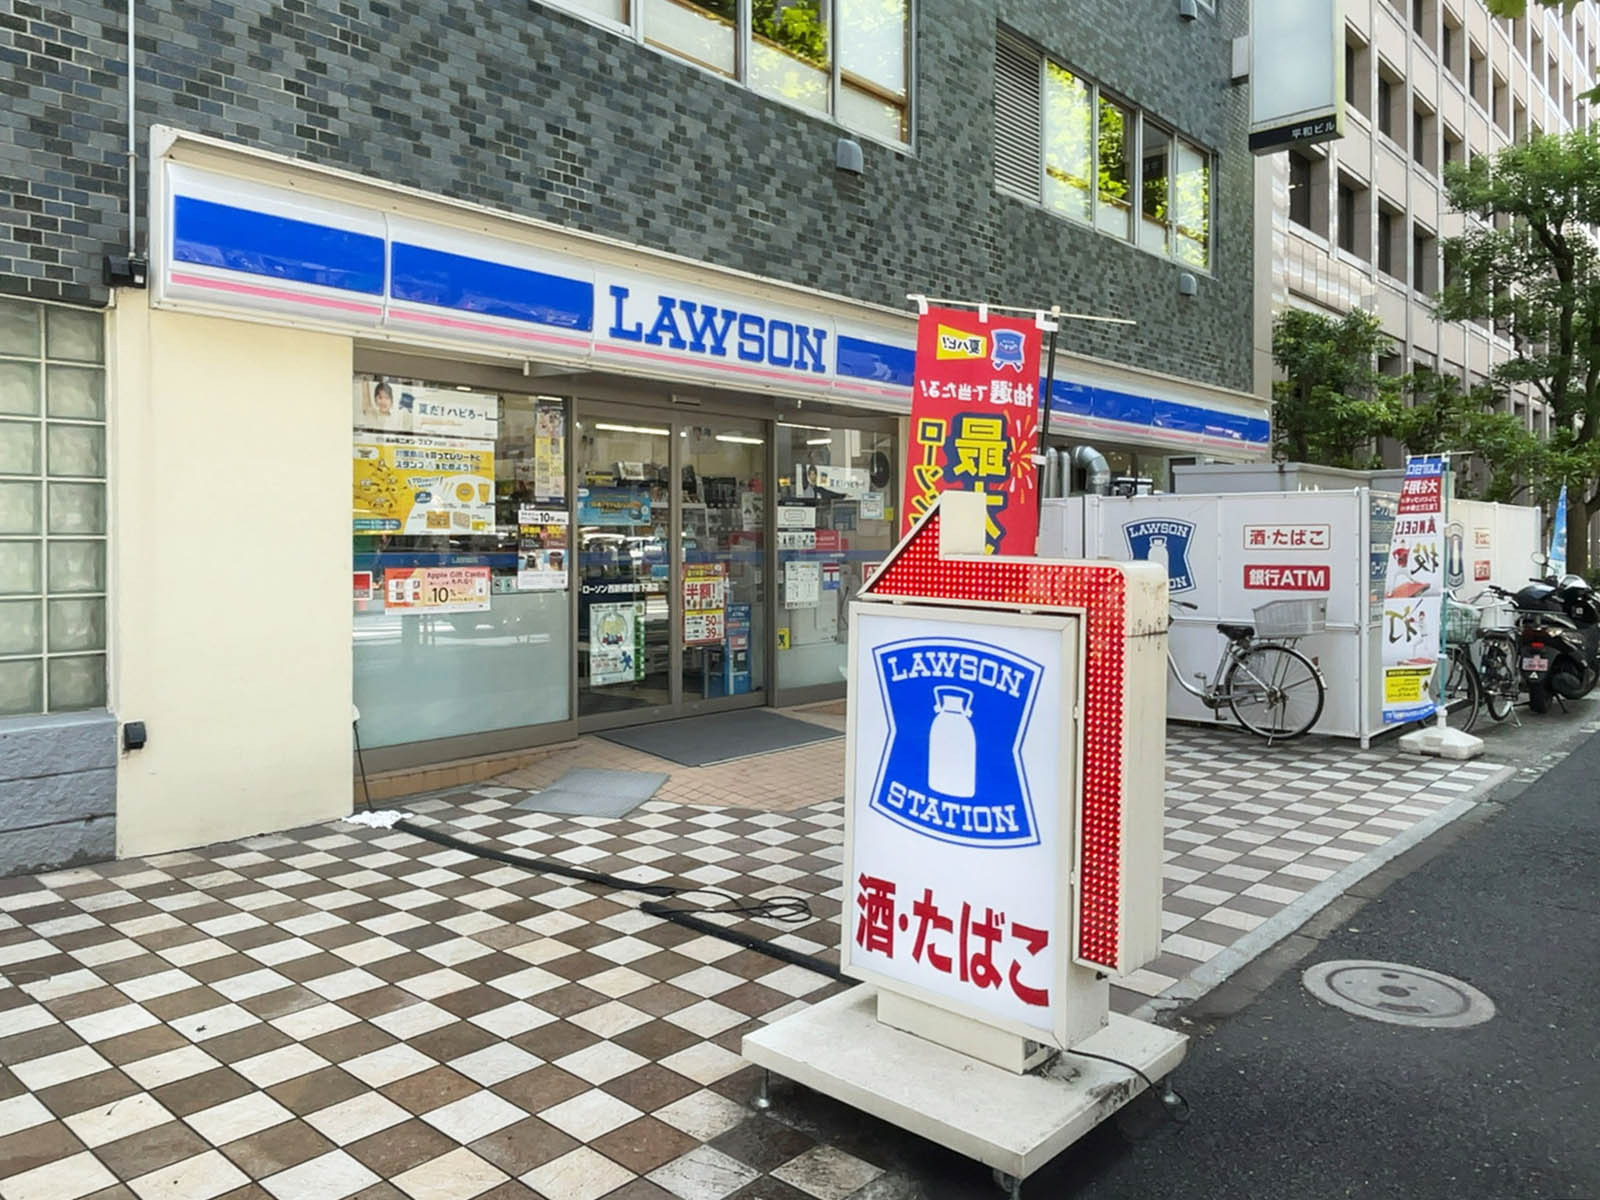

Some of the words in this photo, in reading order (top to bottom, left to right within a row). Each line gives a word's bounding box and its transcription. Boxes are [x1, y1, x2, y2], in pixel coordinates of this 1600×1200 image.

[1291, 121, 1335, 139] 平和ビル
[608, 284, 827, 374] LAWSON
[1128, 523, 1189, 538] LAWSON
[427, 572, 447, 580] Apple
[1249, 568, 1325, 587] 銀行ATM
[686, 583, 716, 600] 半額!
[887, 652, 1026, 699] LAWSON
[887, 780, 1021, 836] STATION
